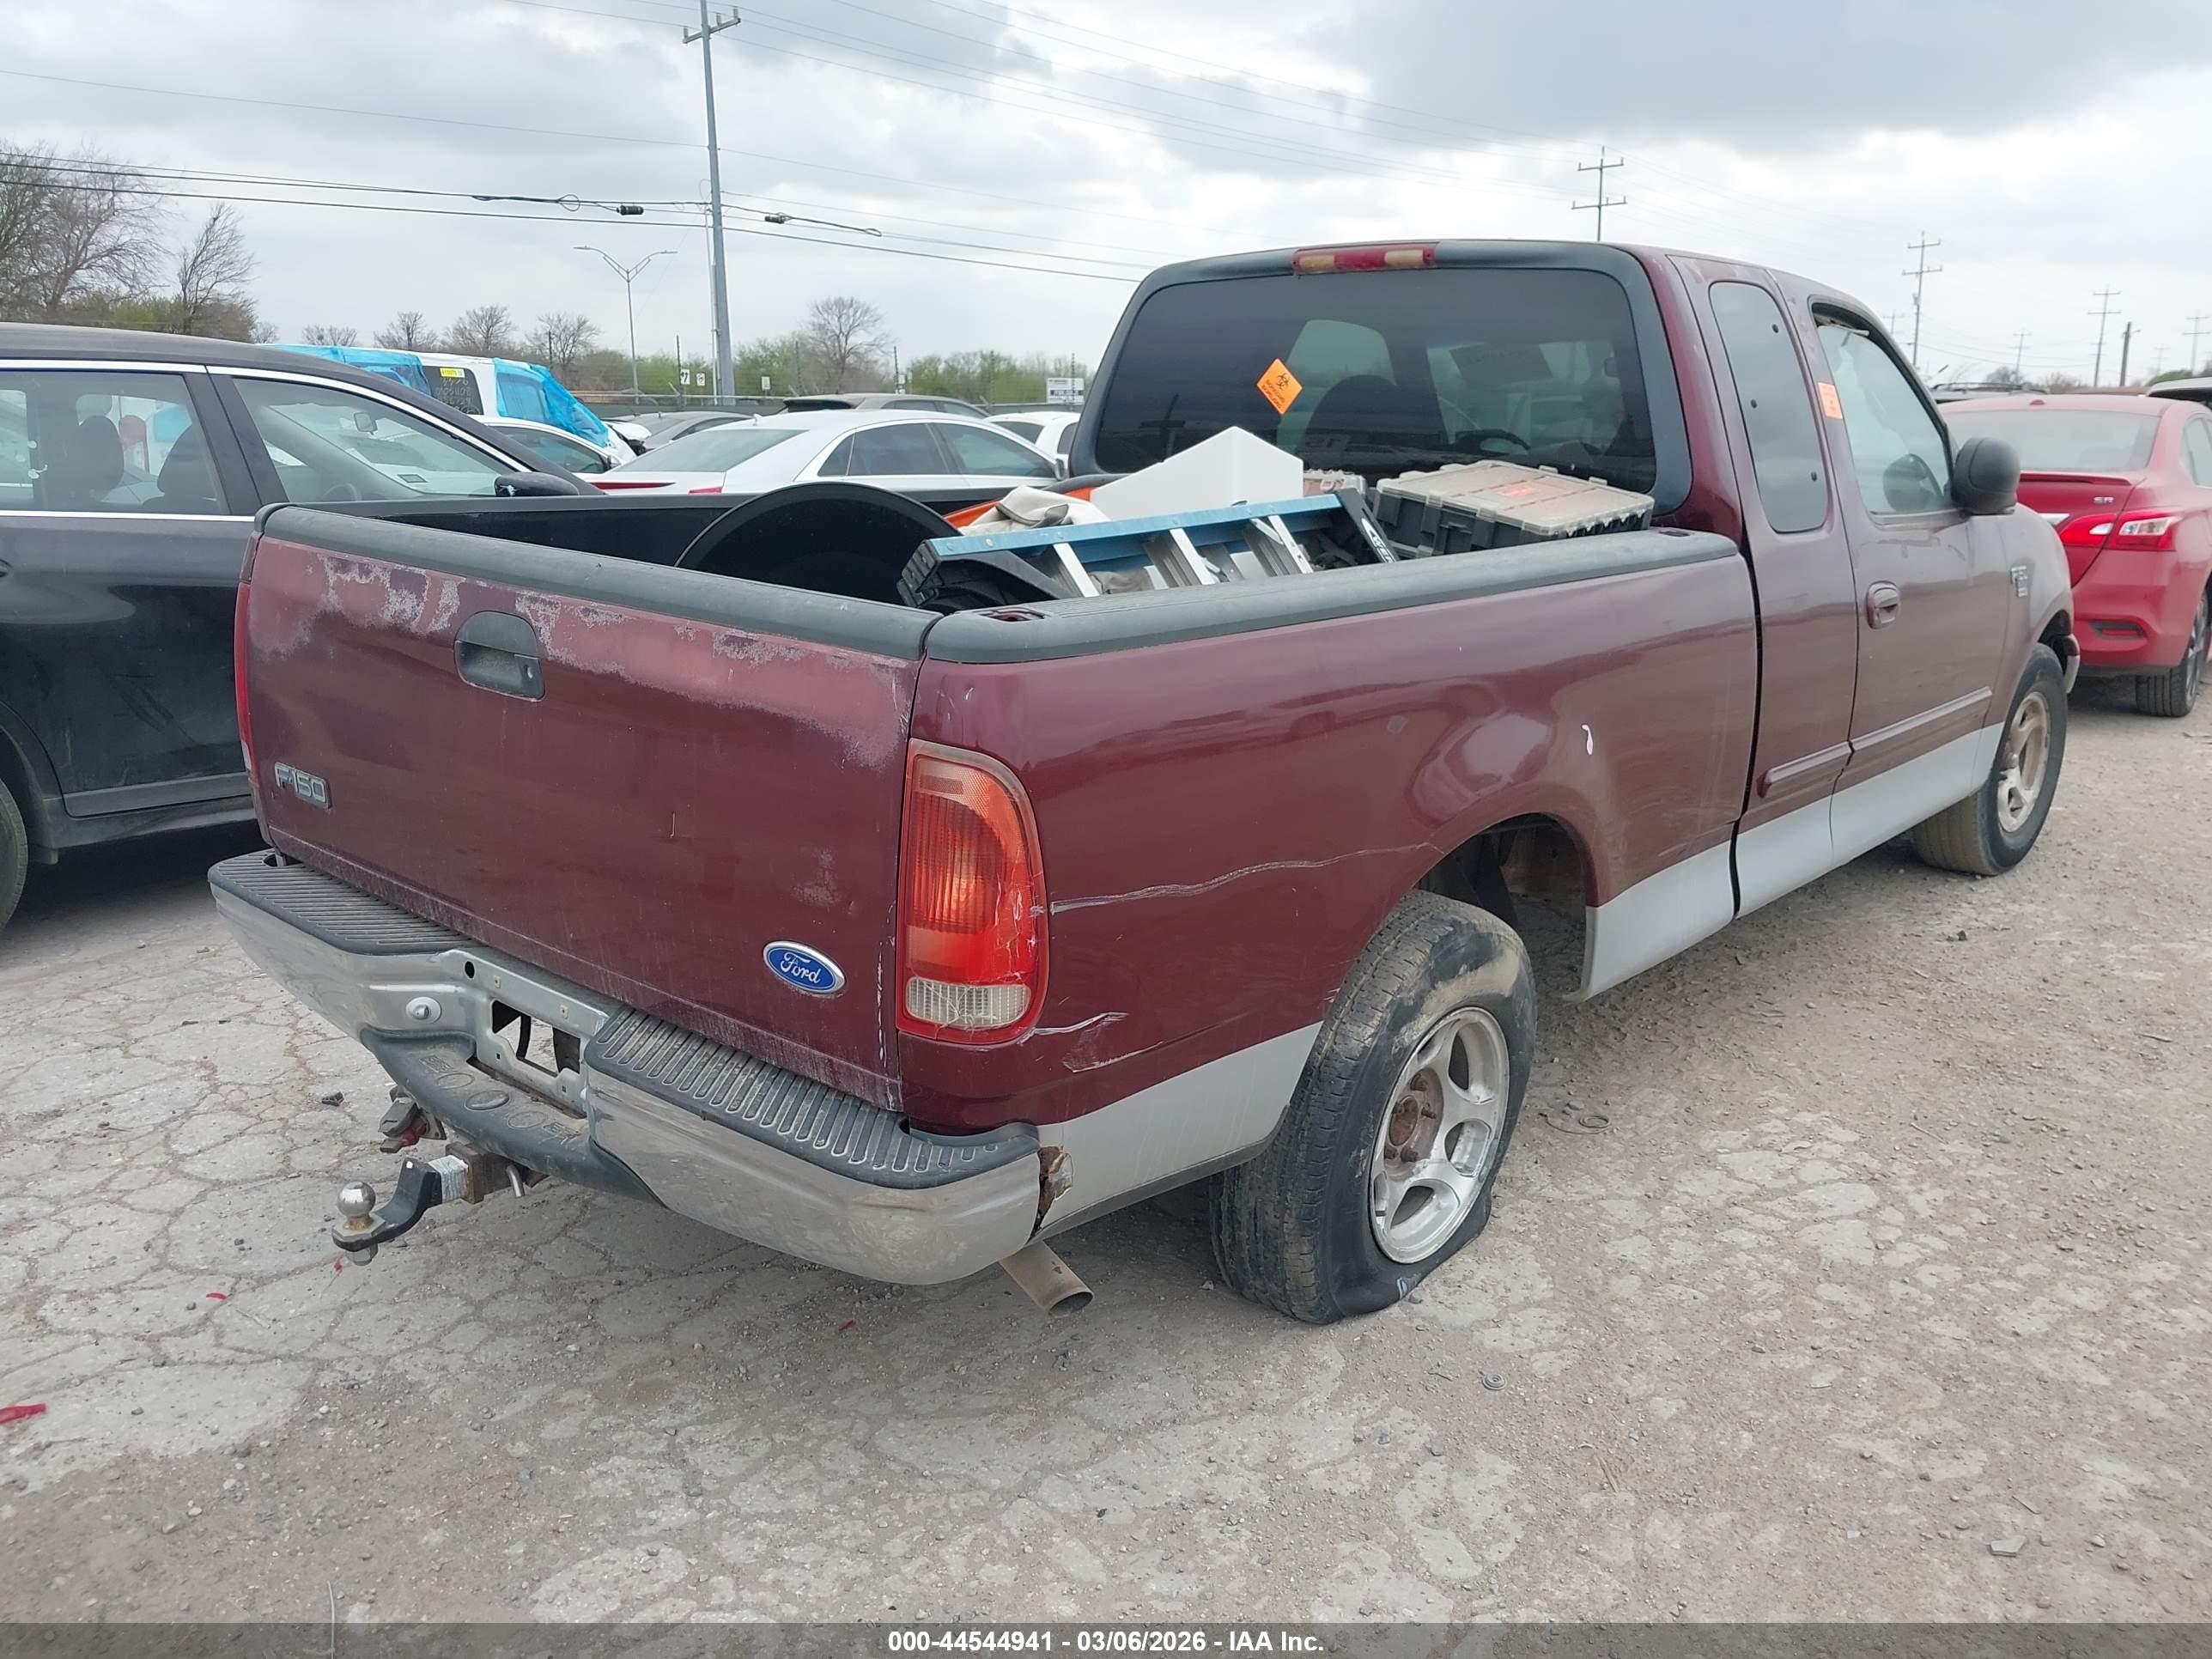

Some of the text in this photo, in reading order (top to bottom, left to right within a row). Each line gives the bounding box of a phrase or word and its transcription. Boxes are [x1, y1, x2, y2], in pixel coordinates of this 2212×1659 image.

[2093, 496, 2114, 505] SR
[274, 763, 326, 804] F-150
[780, 951, 822, 984] Ford
